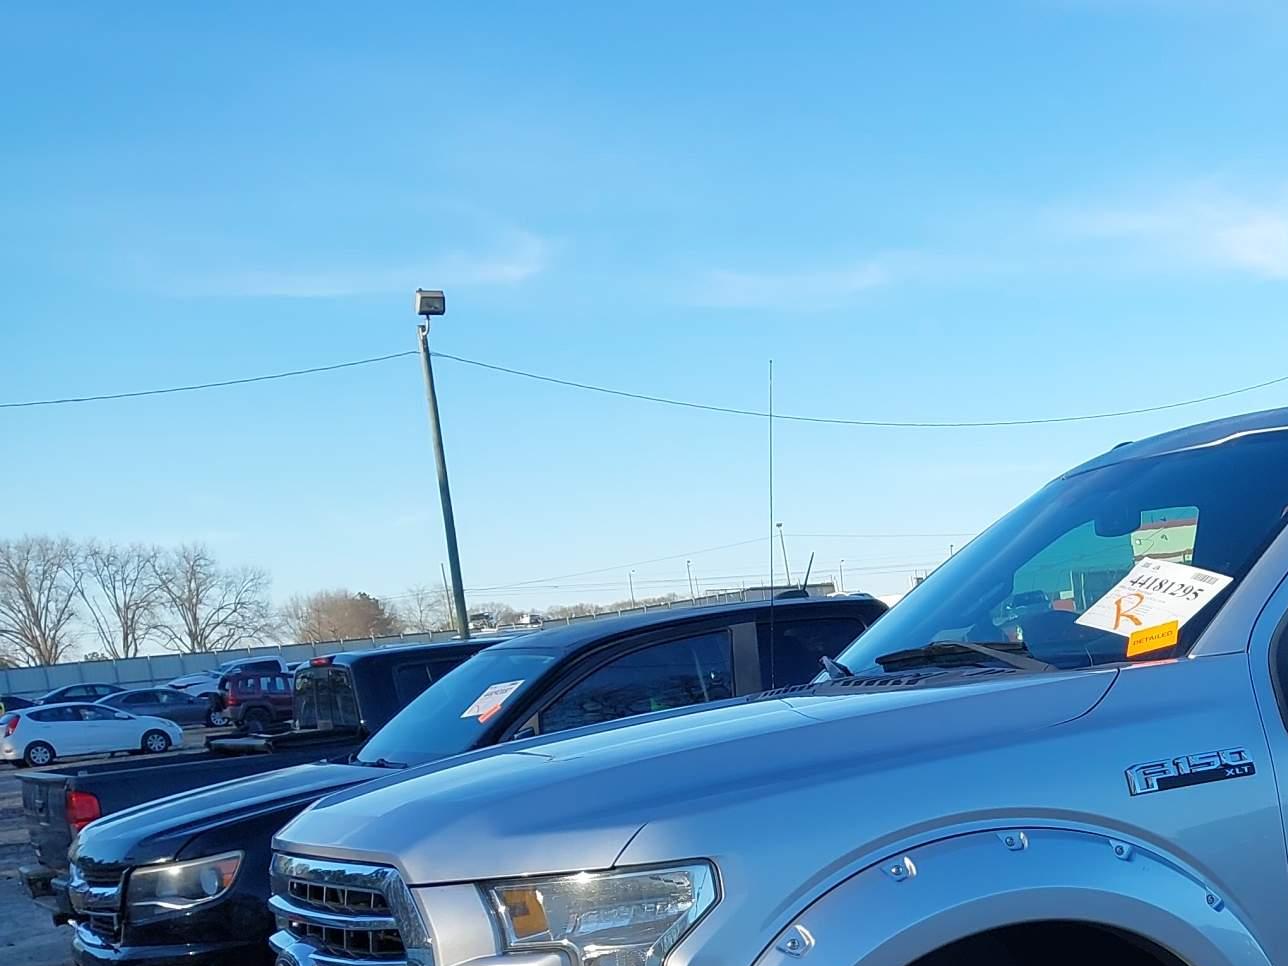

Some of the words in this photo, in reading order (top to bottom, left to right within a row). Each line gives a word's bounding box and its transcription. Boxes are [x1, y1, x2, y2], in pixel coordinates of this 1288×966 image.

[1129, 574, 1205, 601] 44181295
[1113, 592, 1143, 630] R
[1133, 630, 1173, 645] DETAILED
[1225, 766, 1251, 777] XLT
